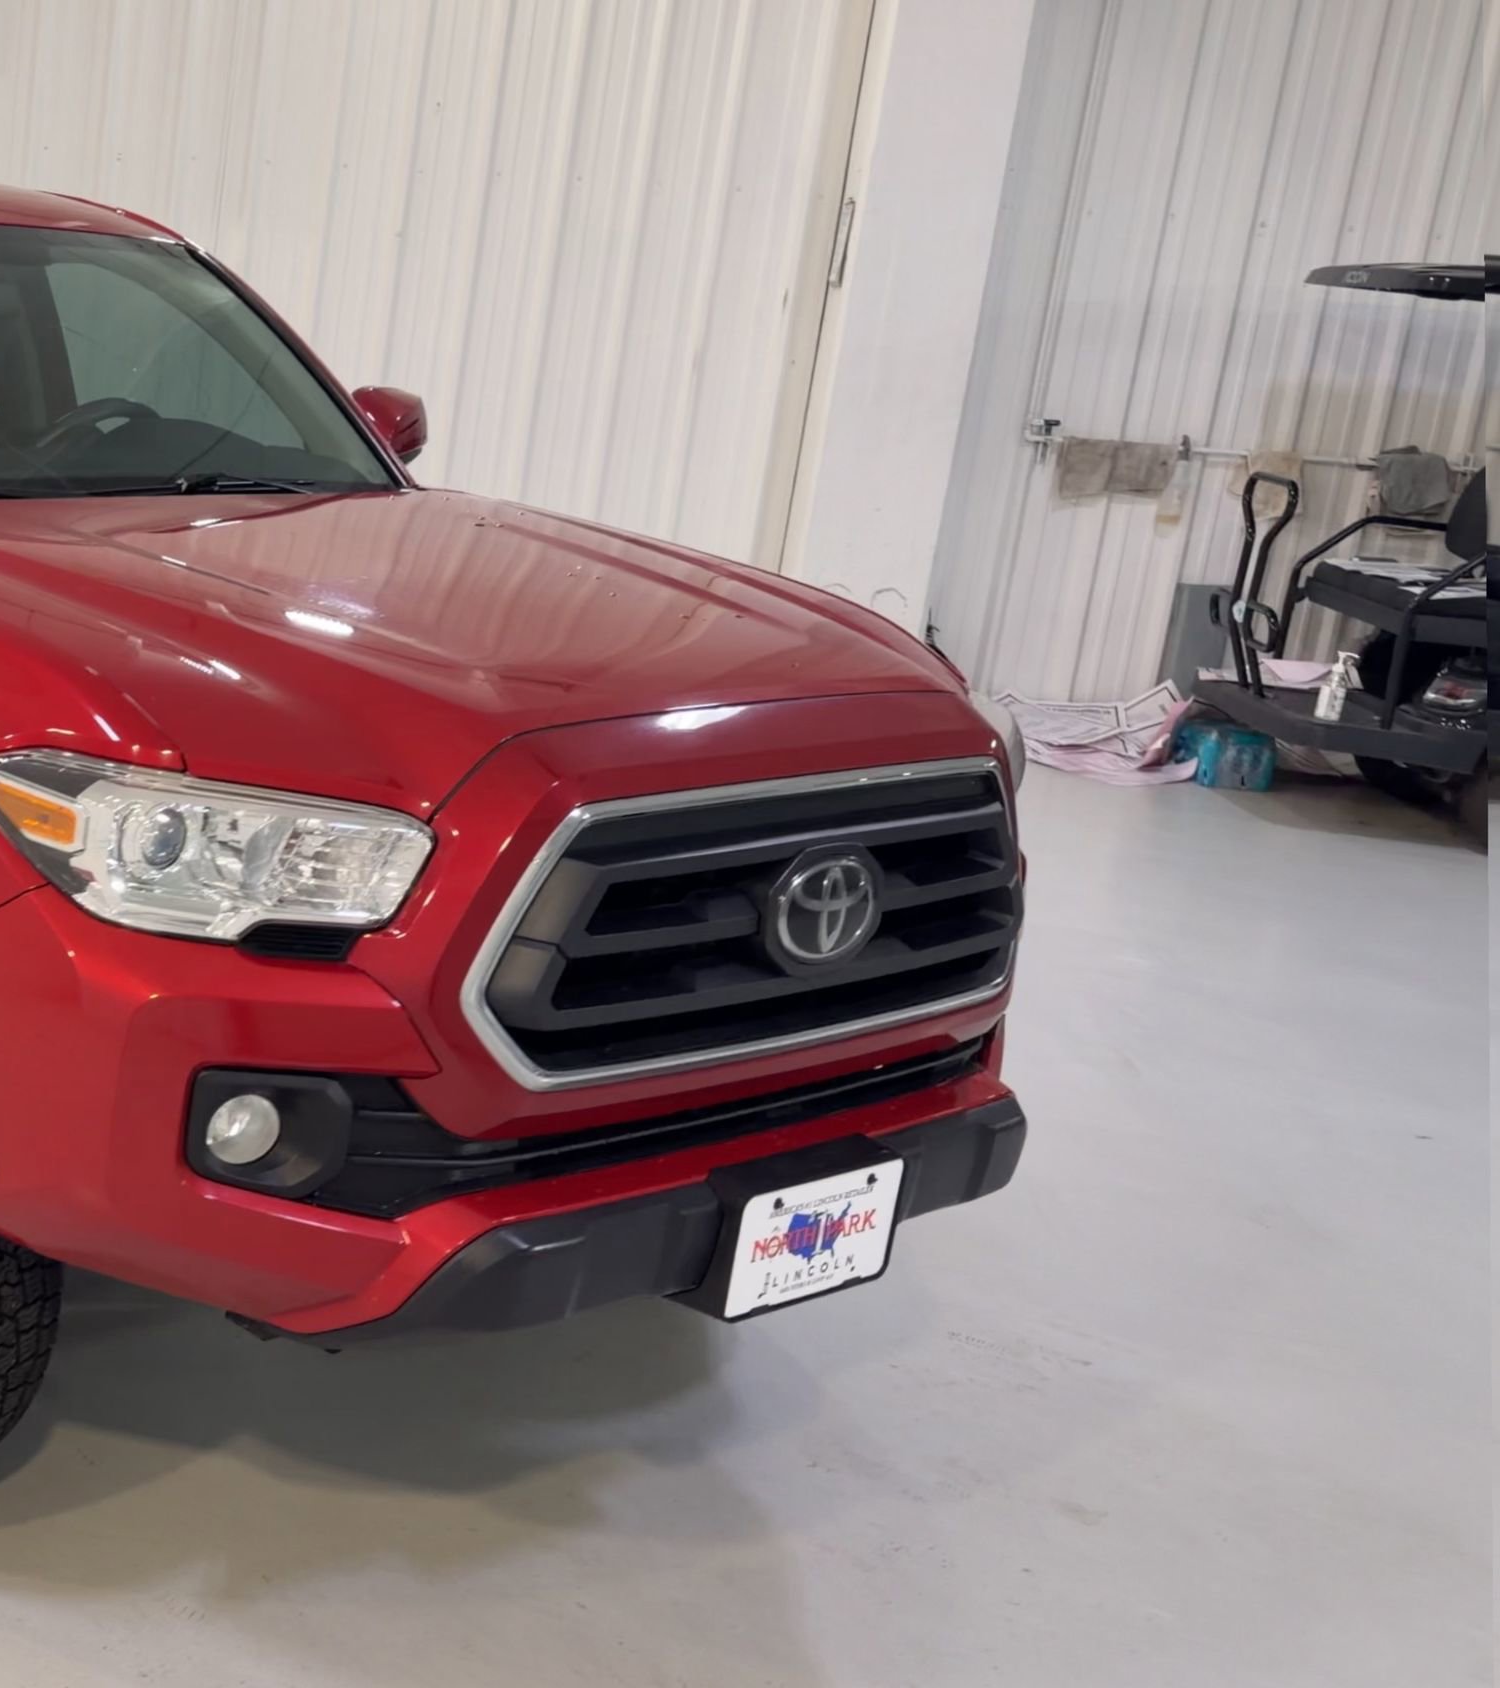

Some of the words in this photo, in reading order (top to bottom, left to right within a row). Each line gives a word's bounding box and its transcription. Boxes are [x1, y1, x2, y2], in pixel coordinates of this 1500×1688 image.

[751, 1225, 816, 1263] NORTH
[826, 1208, 877, 1239] PARK
[772, 1255, 855, 1288] LINCOLN
